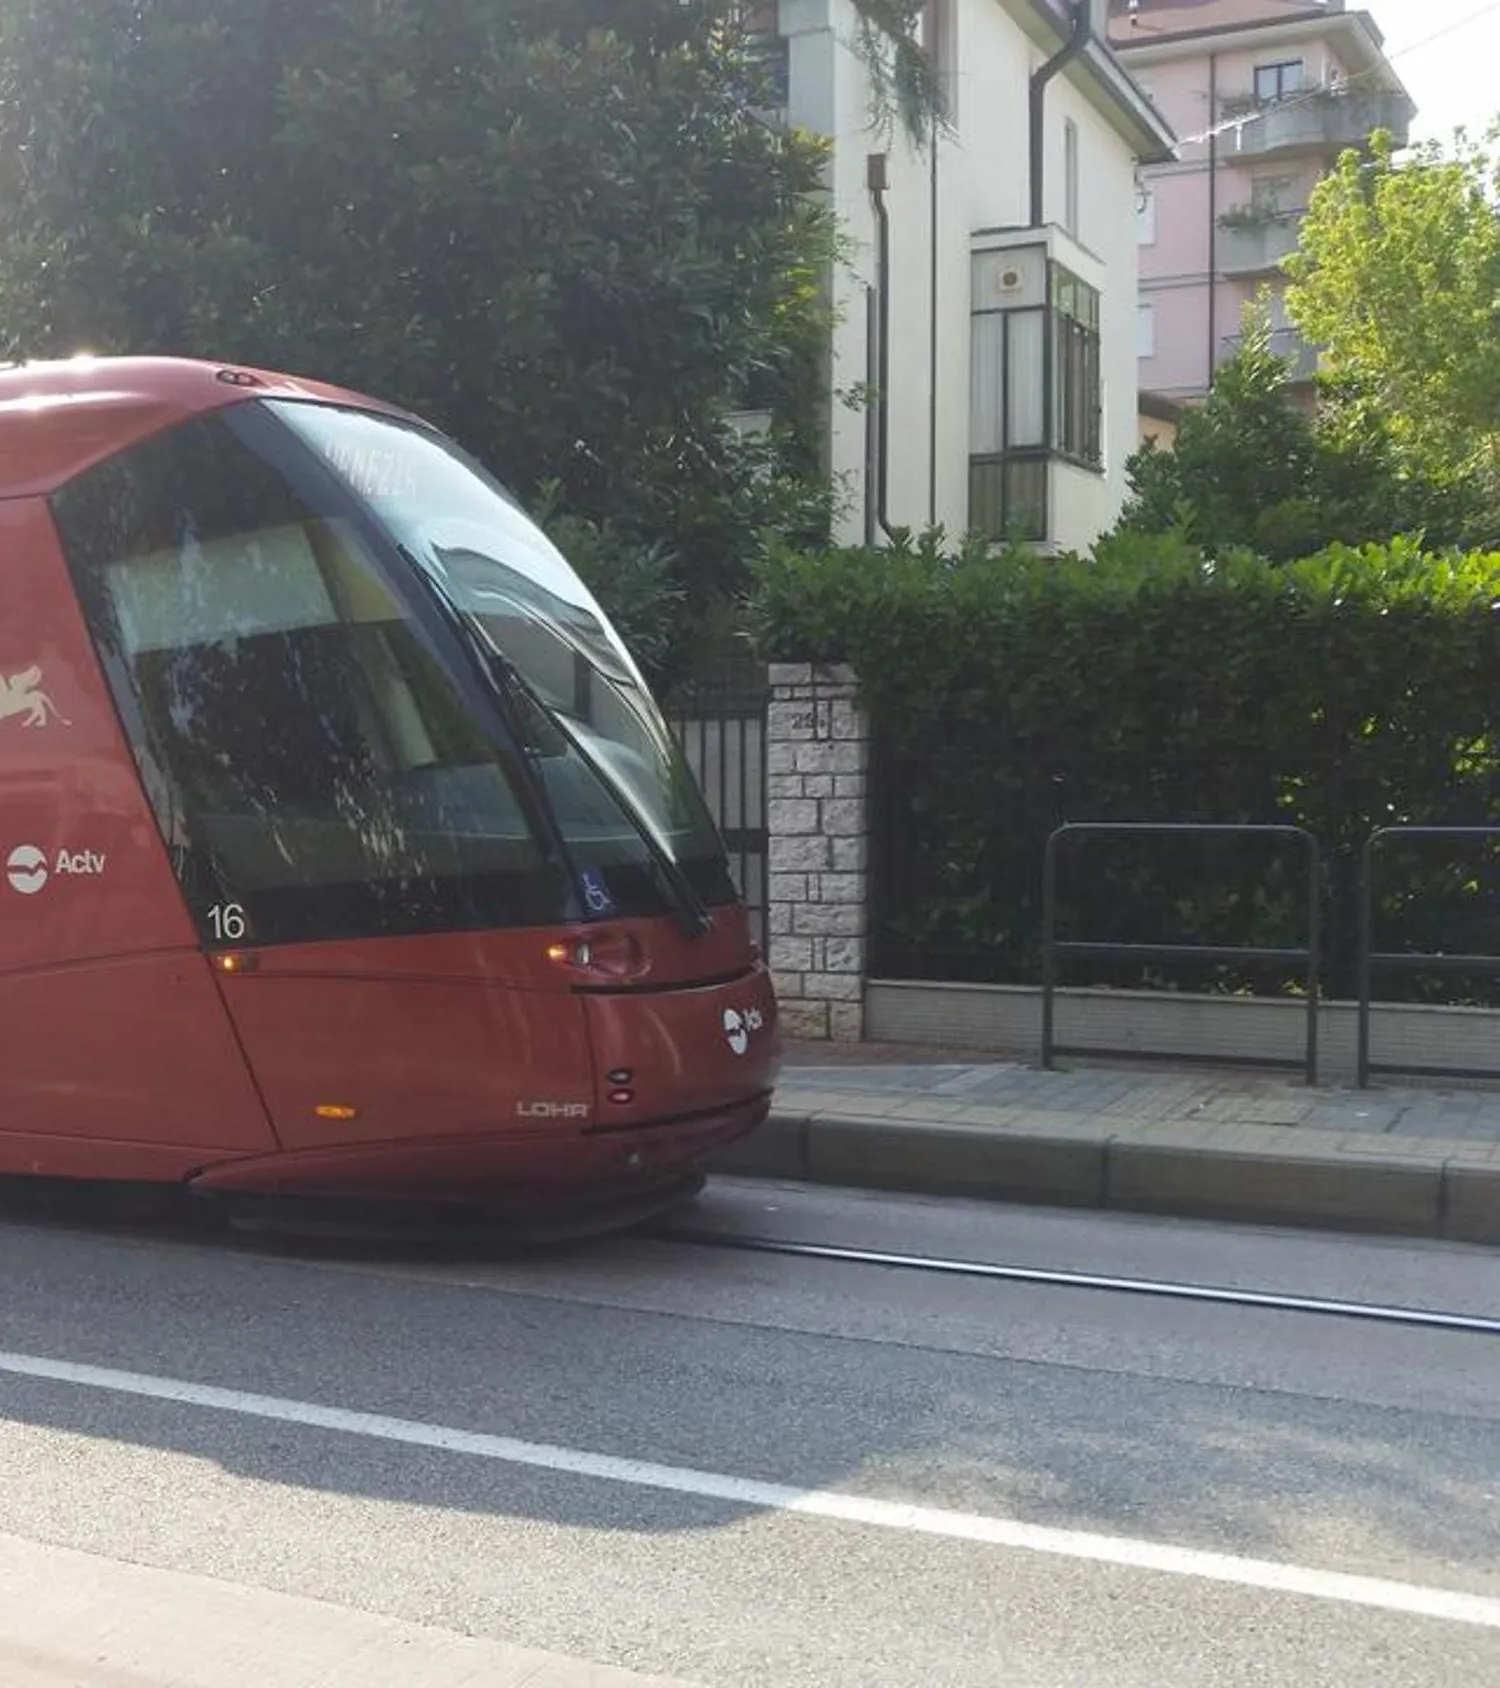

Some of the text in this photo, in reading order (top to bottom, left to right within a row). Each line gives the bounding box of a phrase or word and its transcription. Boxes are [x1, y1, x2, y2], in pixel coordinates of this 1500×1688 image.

[55, 849, 106, 874] Actv
[207, 904, 244, 939] 16
[516, 1102, 588, 1117] LOHR
